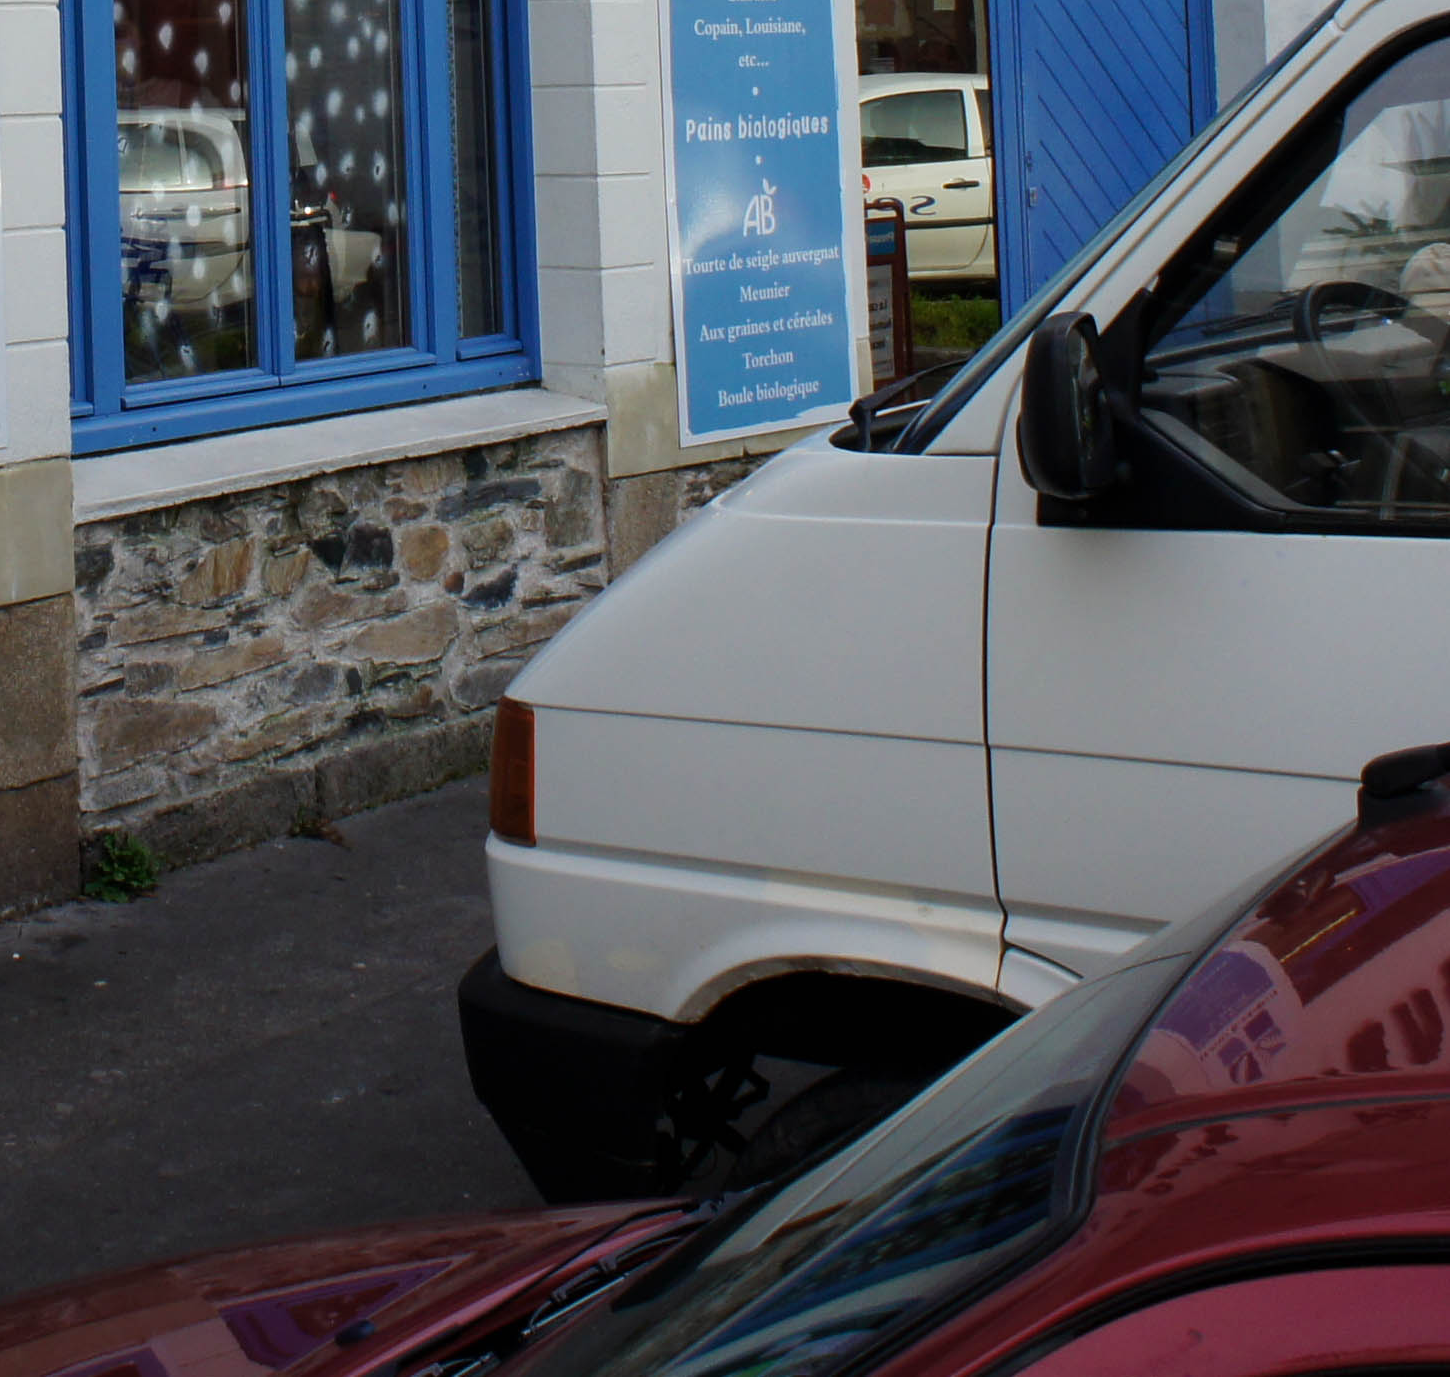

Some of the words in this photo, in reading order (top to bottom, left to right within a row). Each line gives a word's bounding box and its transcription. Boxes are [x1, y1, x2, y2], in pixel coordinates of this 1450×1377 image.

[685, 116, 732, 144] Pains
[737, 113, 829, 141] biologiques
[743, 193, 776, 237] AB
[683, 253, 726, 276] Tourte
[729, 253, 744, 271] de
[746, 250, 779, 273] seigle
[782, 245, 840, 270] auvergnat
[740, 283, 790, 303] Meunier
[699, 323, 726, 343] Aux
[728, 319, 770, 344] graines
[773, 317, 785, 332] et
[786, 311, 833, 331] céréales
[742, 350, 794, 370] Torchon
[718, 387, 754, 408] Boule
[756, 378, 819, 403] biologique
